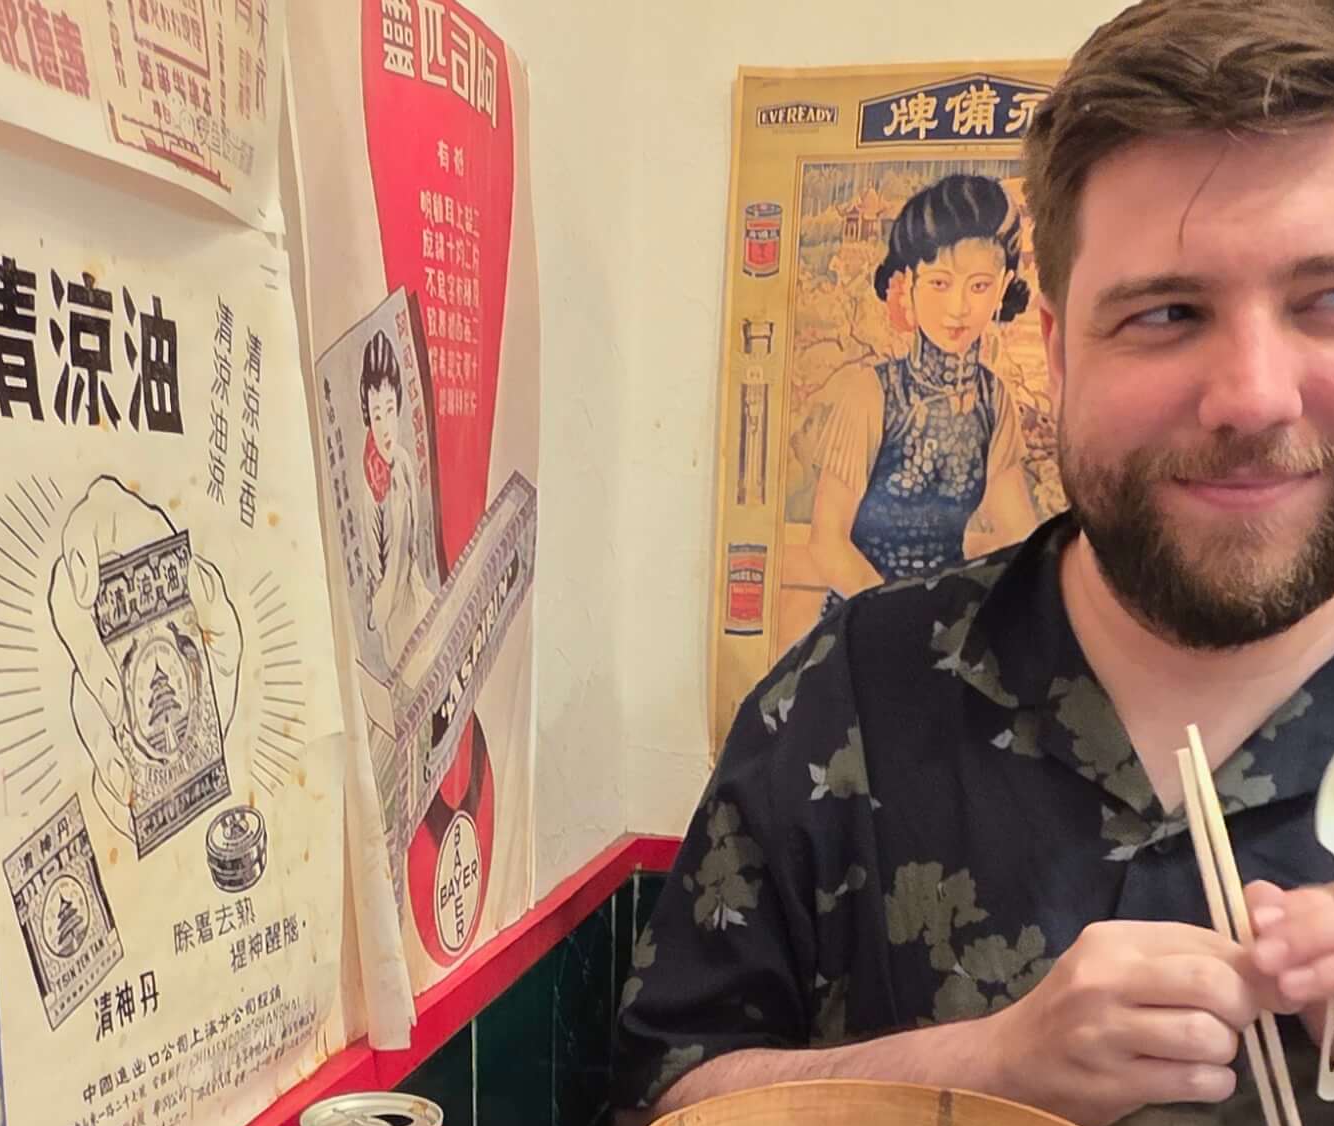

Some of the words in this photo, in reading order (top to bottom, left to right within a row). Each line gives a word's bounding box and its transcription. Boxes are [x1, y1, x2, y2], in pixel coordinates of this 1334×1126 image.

[757, 104, 838, 126] EVEREADY
[440, 859, 479, 911] BAYER
[454, 823, 466, 943] BAYER
[94, 970, 160, 1043] 清神丹
